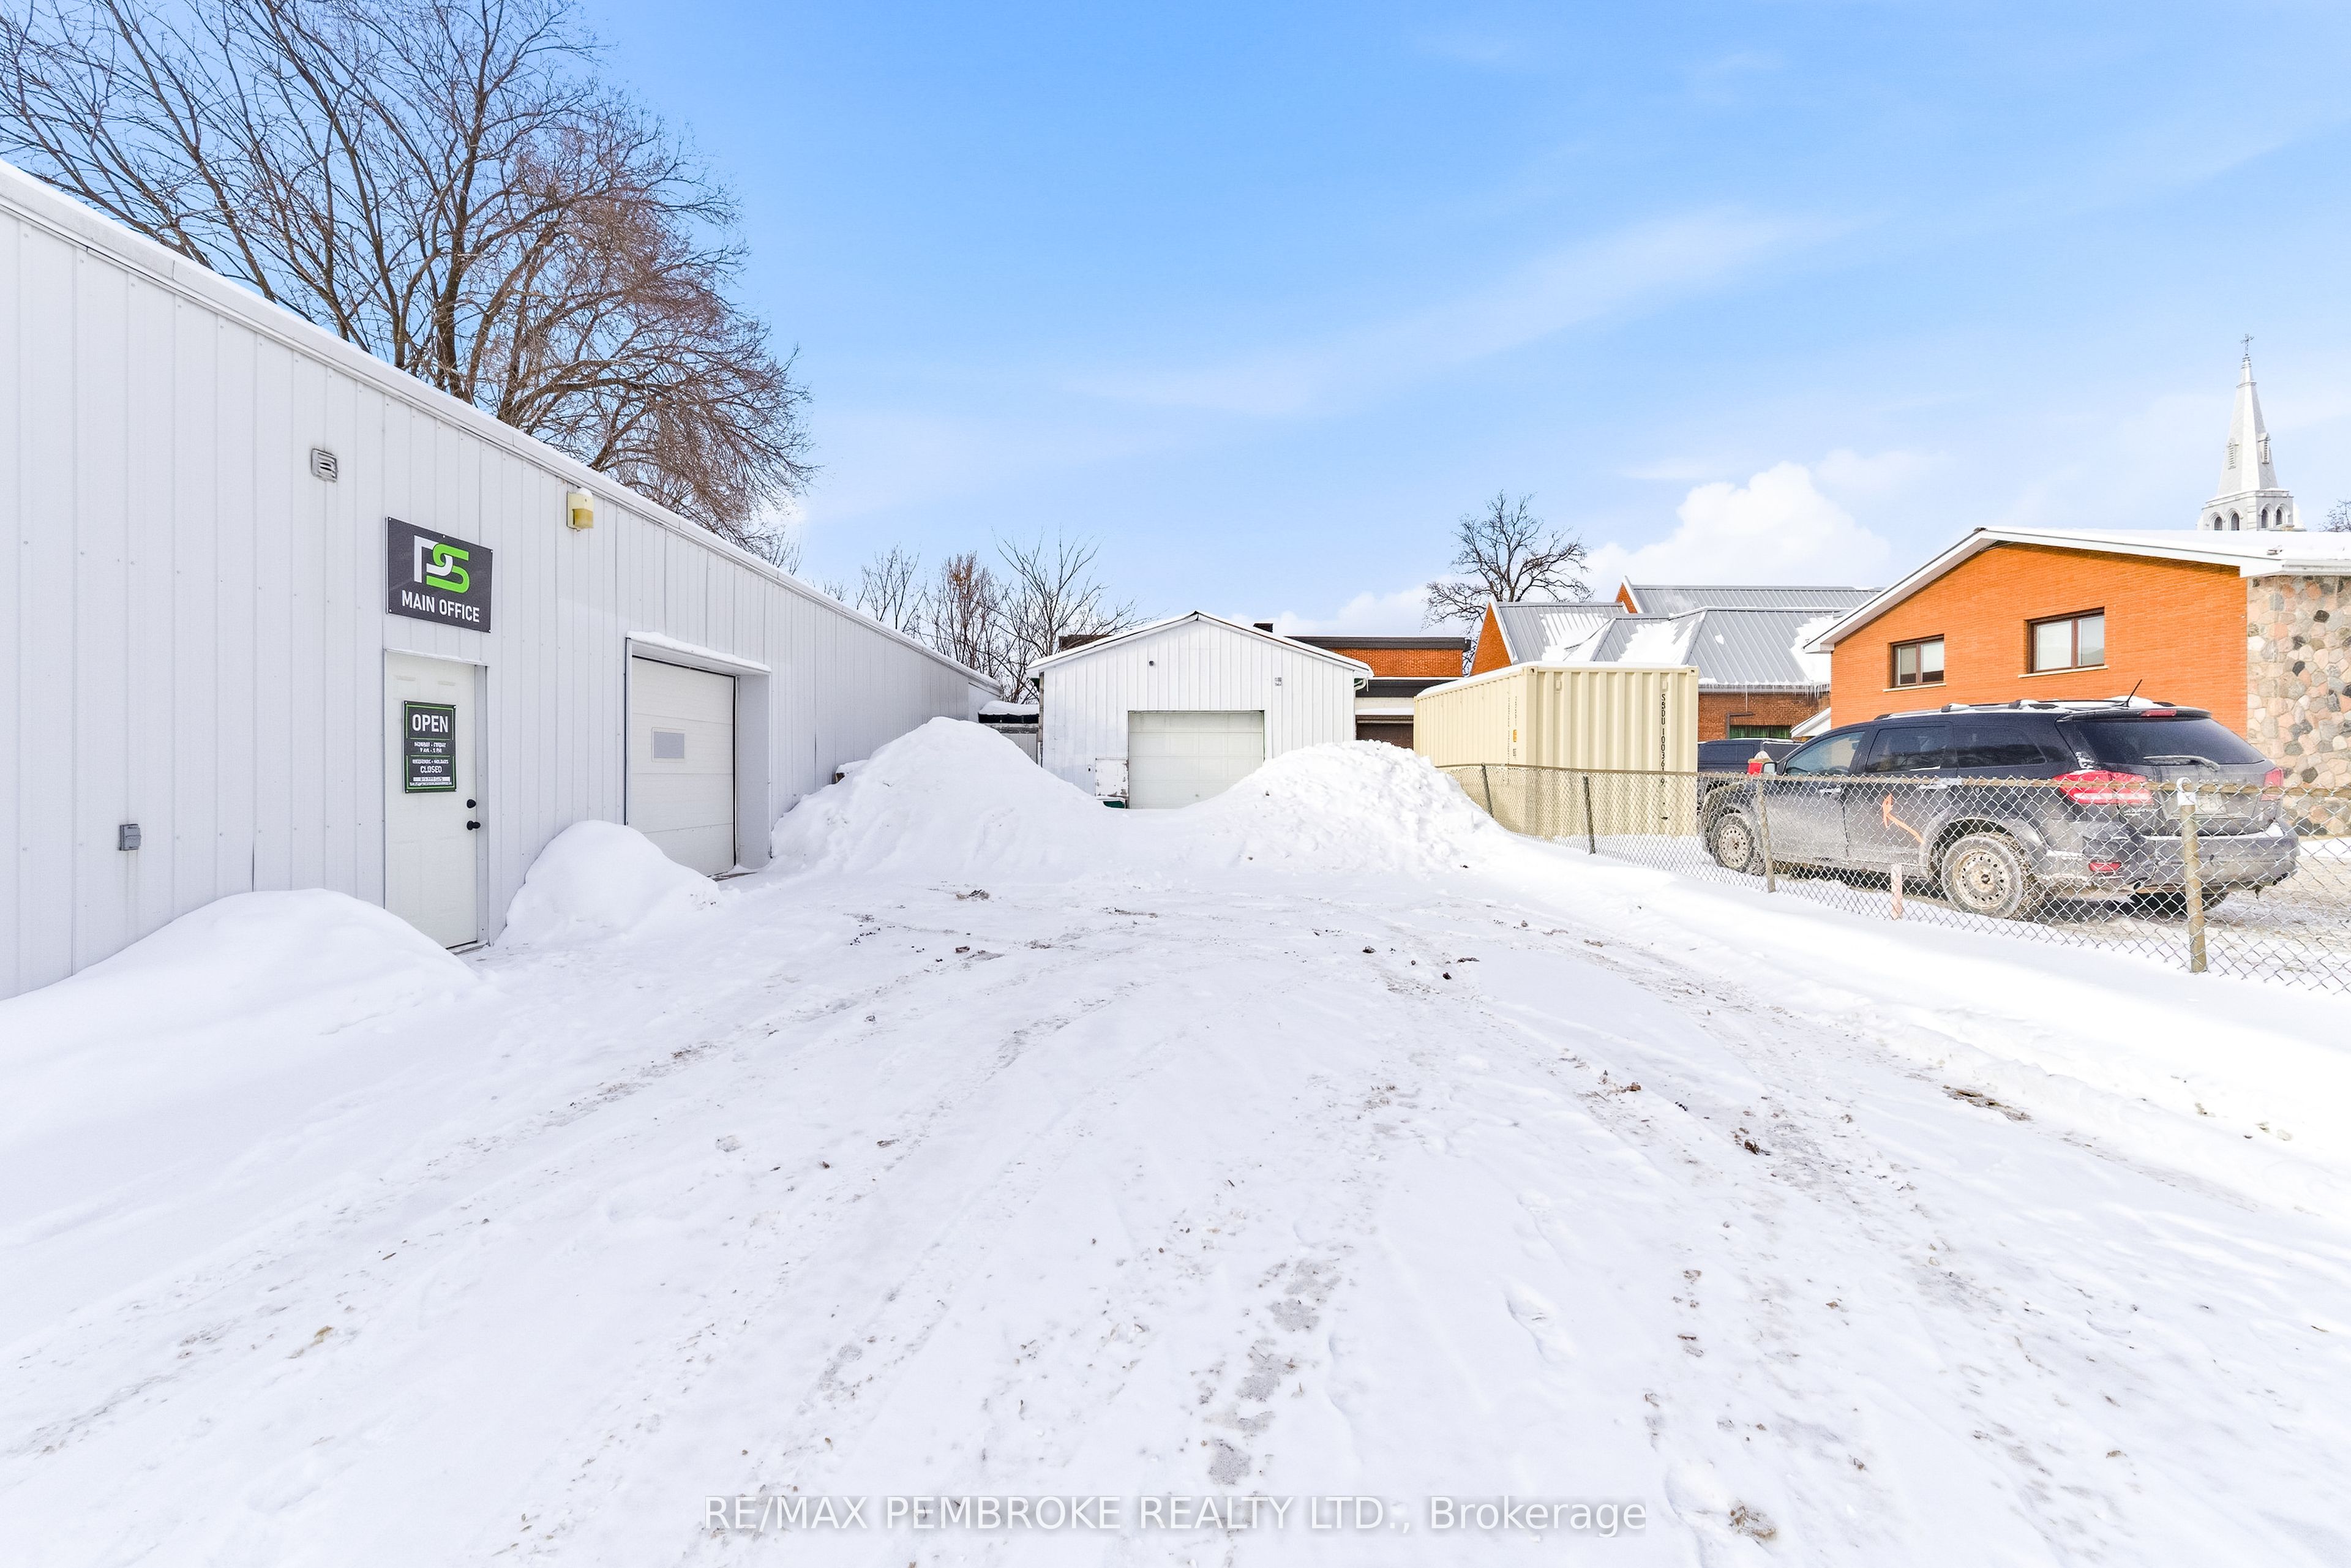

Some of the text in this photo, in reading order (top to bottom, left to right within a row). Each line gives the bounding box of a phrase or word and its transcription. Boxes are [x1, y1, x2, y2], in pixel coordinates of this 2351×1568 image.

[402, 590, 479, 623] MAIN OFFICE
[412, 714, 449, 732] OPEN
